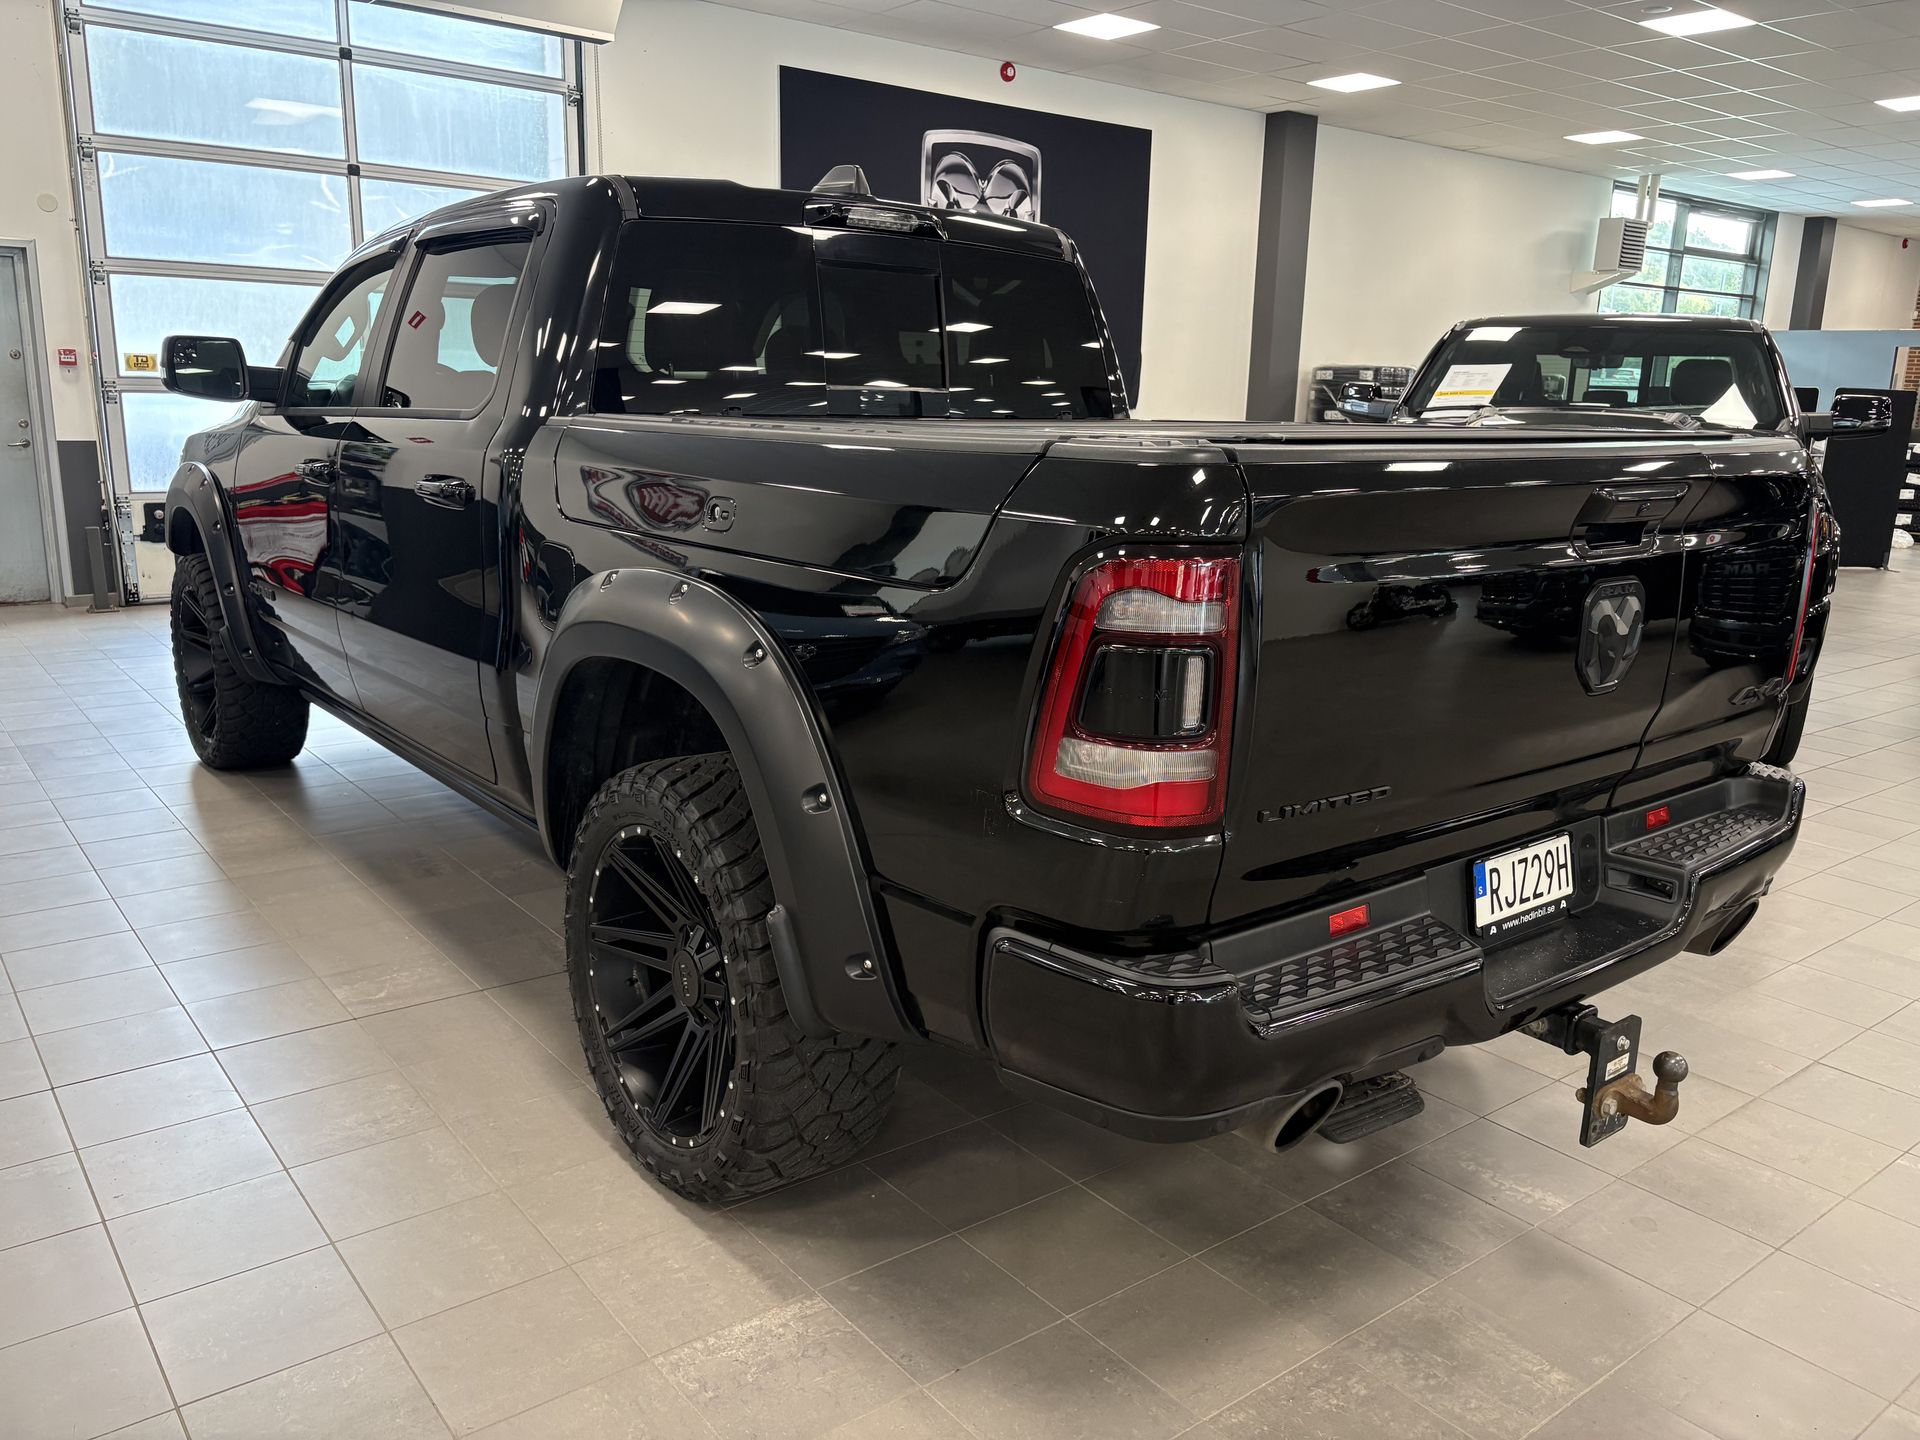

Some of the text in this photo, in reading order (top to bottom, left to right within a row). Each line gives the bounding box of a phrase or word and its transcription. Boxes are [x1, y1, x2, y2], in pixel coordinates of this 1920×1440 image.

[1257, 785, 1392, 823] LIMITED
[1478, 886, 1484, 895] S
[1489, 843, 1570, 915] RJZ29H
[1502, 905, 1555, 930] www.hedinbil.se
